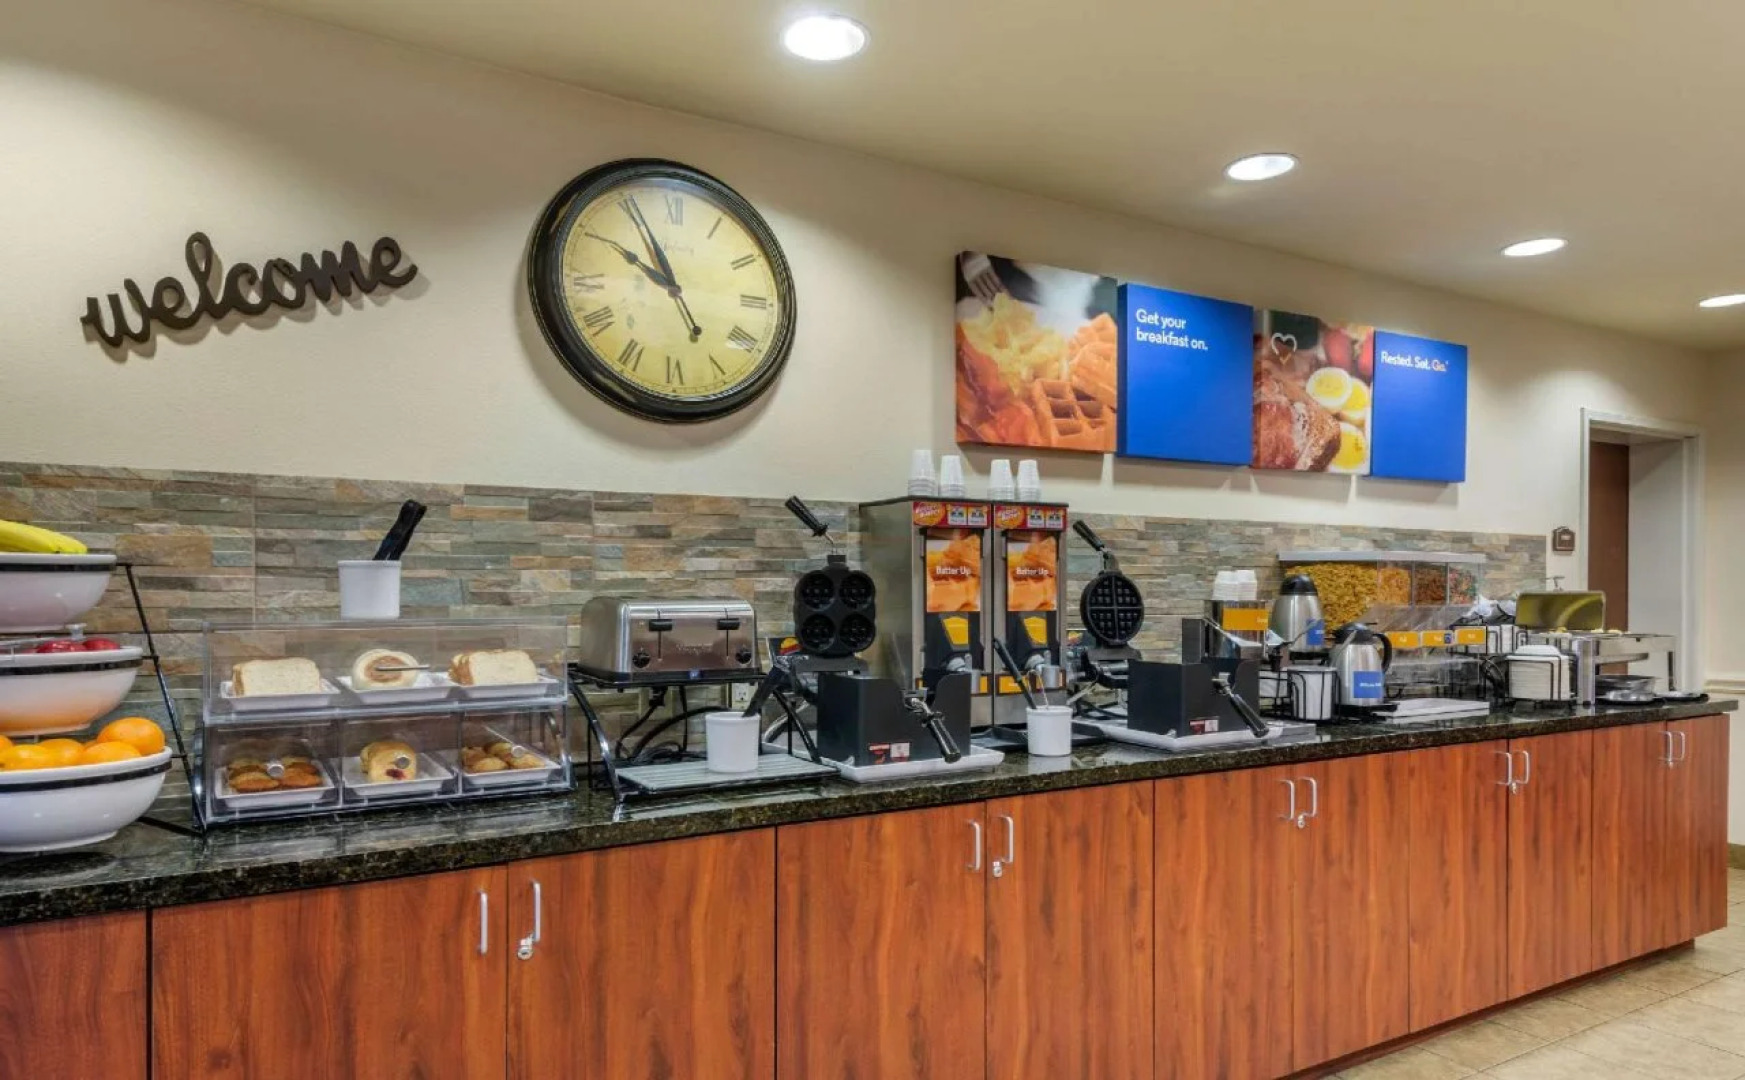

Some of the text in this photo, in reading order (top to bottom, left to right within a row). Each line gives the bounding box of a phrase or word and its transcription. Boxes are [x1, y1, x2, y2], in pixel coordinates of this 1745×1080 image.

[664, 195, 683, 226] XII
[730, 253, 756, 270] II
[80, 232, 418, 347] welcome
[740, 294, 767, 311] III
[1136, 308, 1187, 330] Get your
[1136, 326, 1209, 351] breakfast on.
[1381, 351, 1413, 368] Rested.
[1414, 355, 1431, 371] Set.
